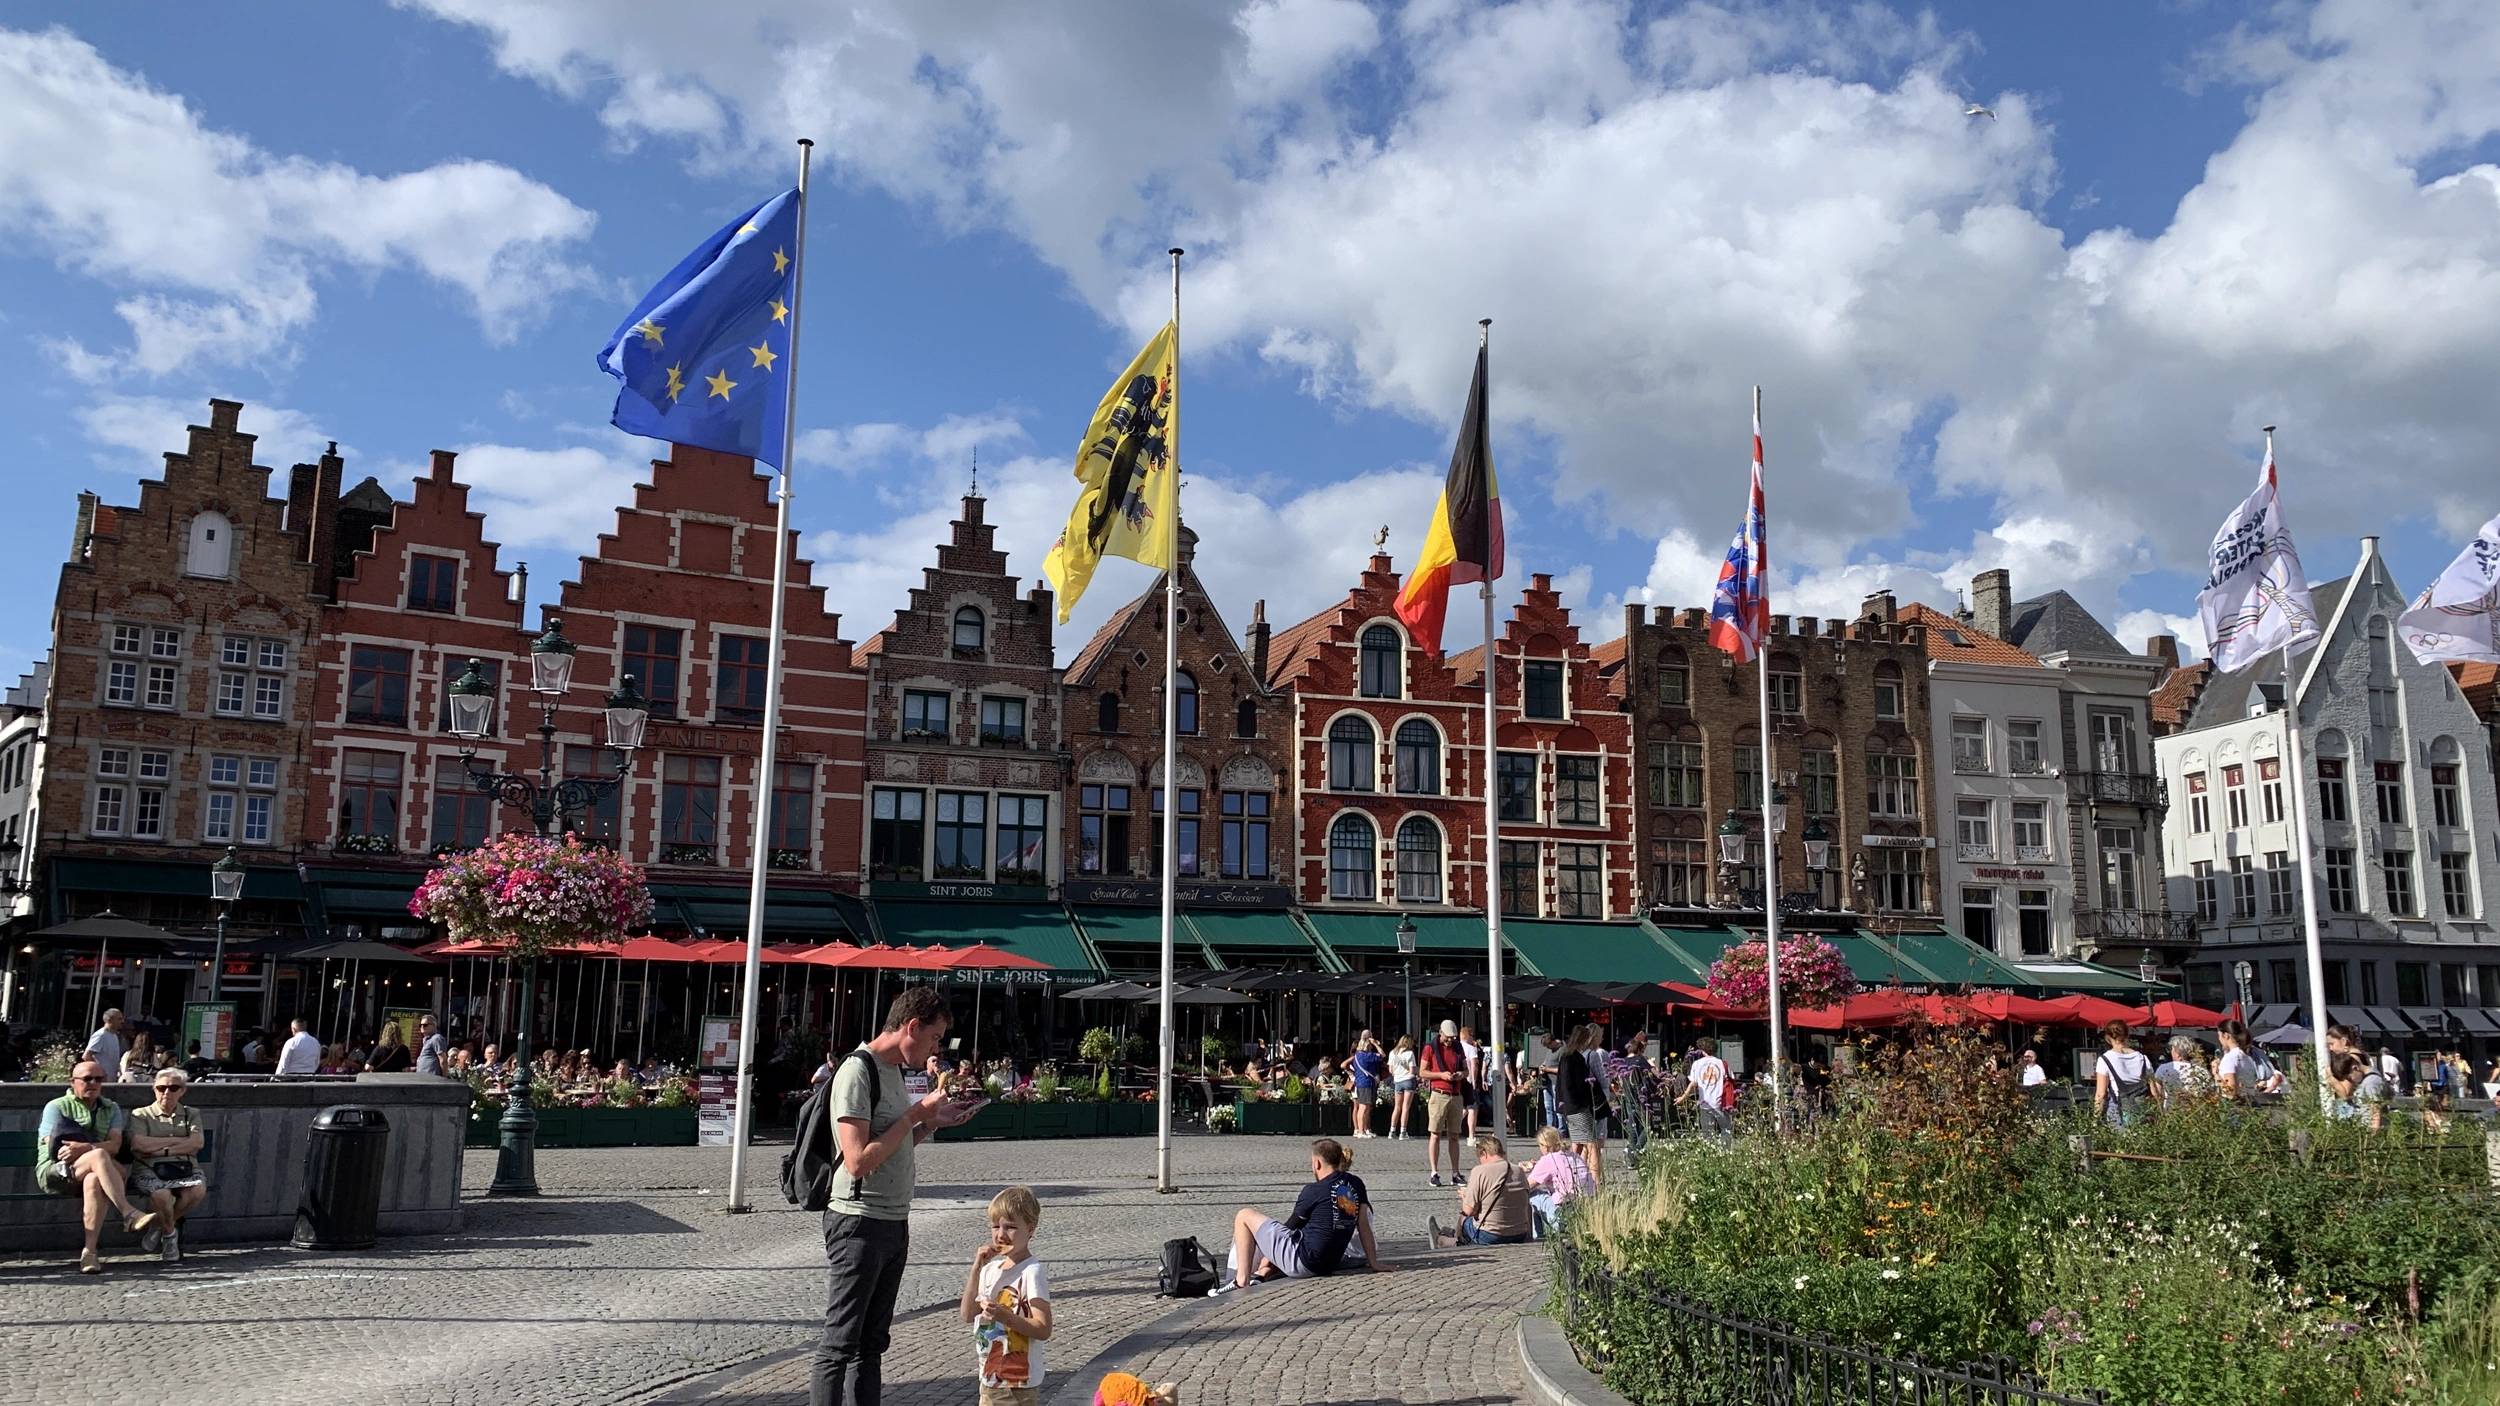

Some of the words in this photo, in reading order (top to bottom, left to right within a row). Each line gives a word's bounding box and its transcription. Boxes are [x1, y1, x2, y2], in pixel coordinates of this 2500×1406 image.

[645, 726, 729, 751] PANIER
[736, 734, 792, 754] D'R
[930, 885, 957, 897] SINT
[960, 886, 993, 898] JORIS
[1089, 888, 1119, 902] Grand
[1216, 891, 1264, 904] Brasserie
[956, 969, 1048, 984] SINT-JORIS
[1056, 975, 1096, 985] Brasserie
[1875, 984, 1928, 994] Resturant
[211, 1004, 233, 1012] PASTA
